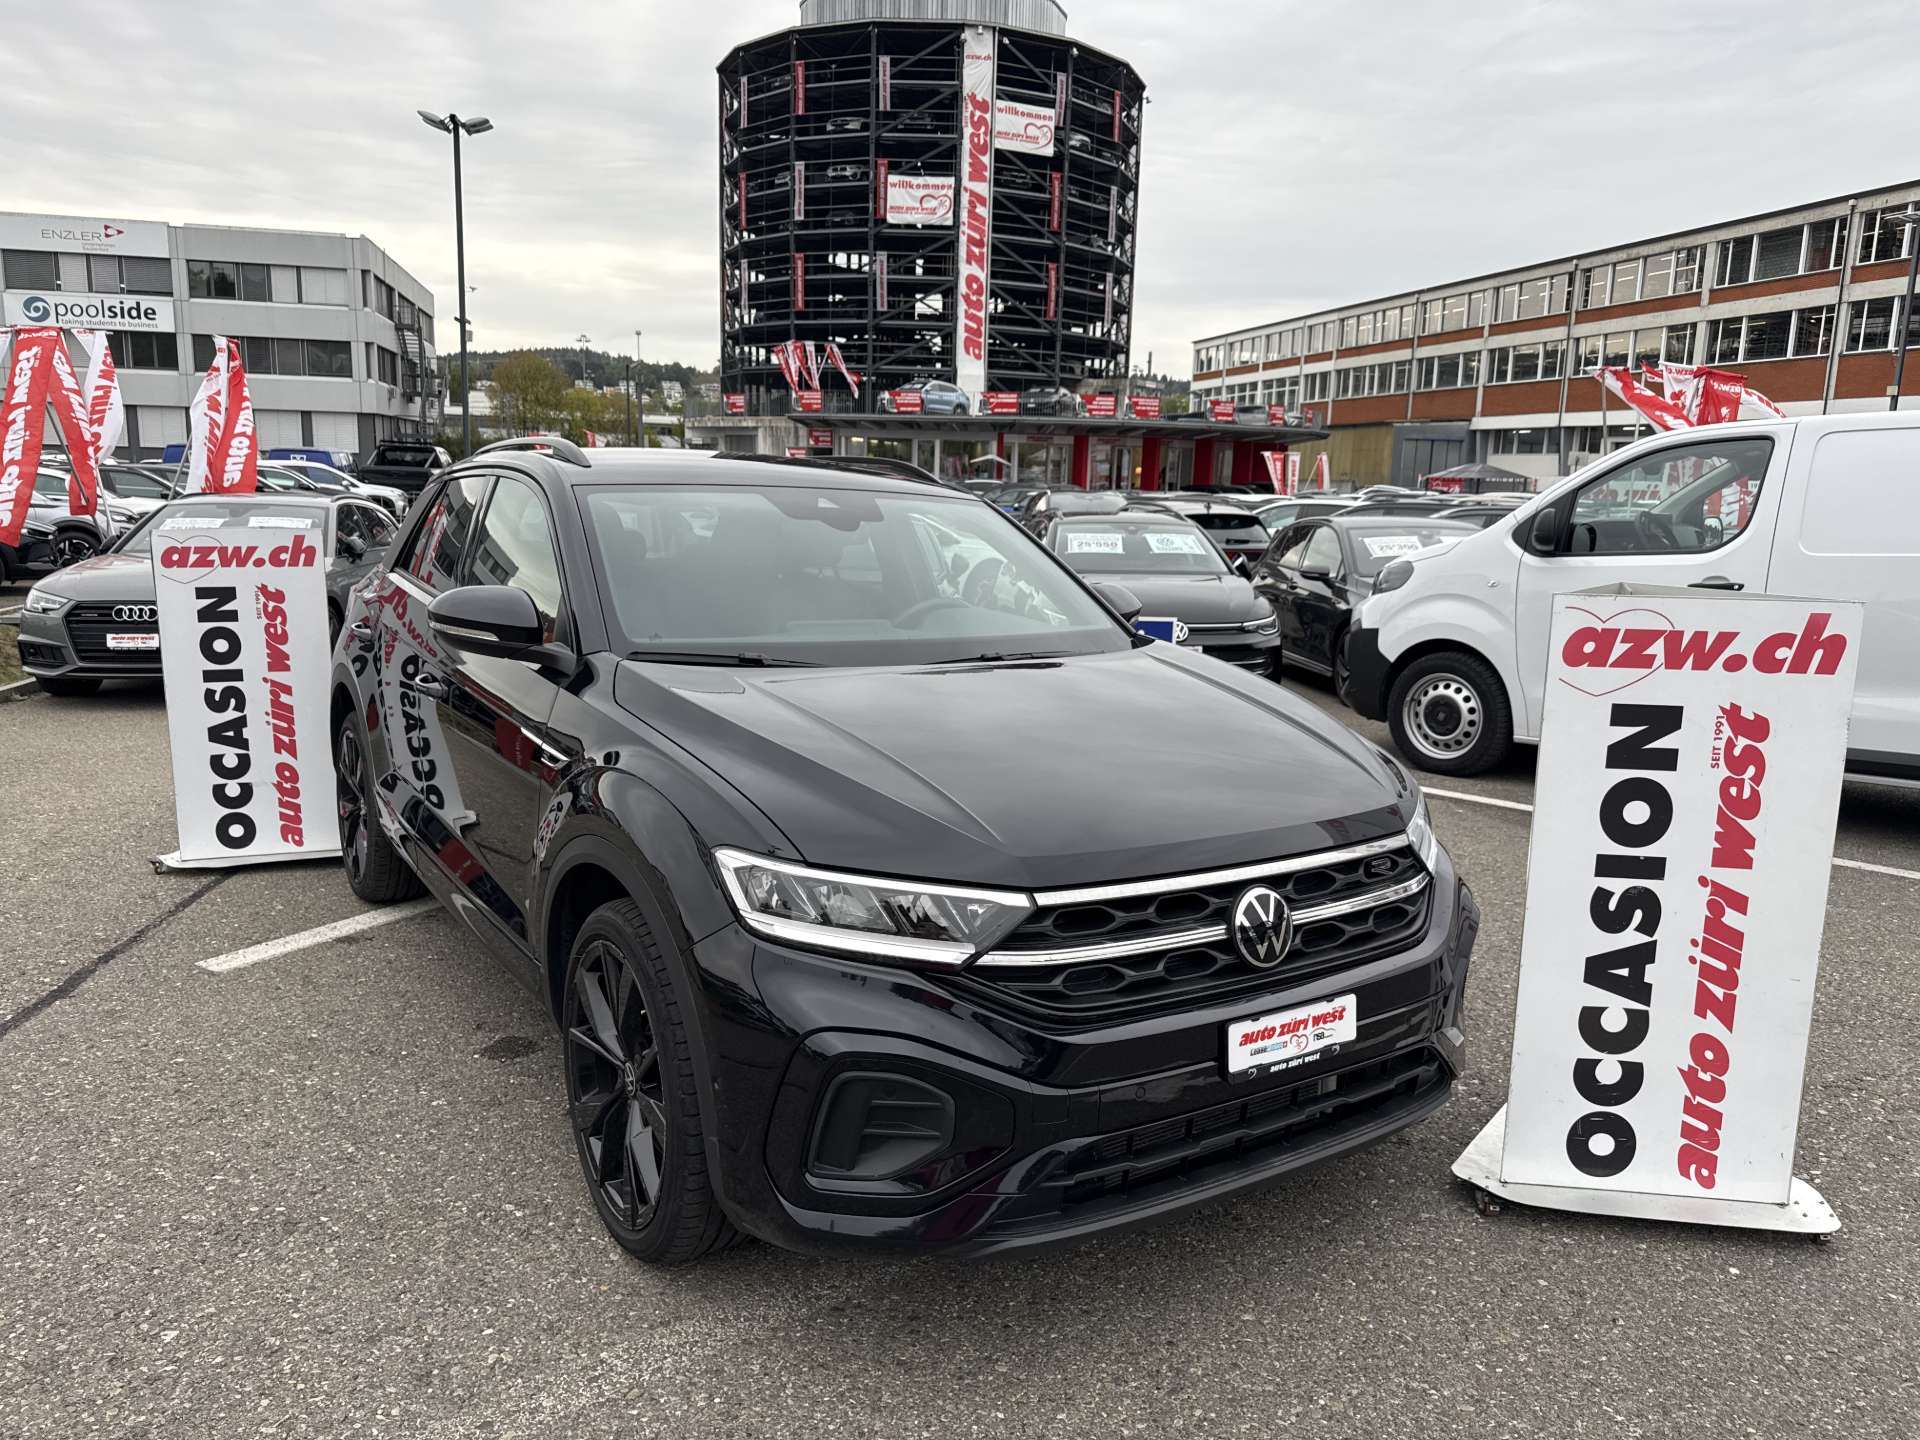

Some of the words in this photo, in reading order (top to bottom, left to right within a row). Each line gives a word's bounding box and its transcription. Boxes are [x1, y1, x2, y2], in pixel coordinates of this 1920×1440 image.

[967, 91, 990, 184] west
[996, 105, 1053, 121] willkommen
[889, 180, 952, 191] willkommen
[41, 228, 102, 242] ENZLER
[961, 186, 988, 271] züri
[54, 299, 157, 323] poolside
[61, 317, 84, 328] taking
[86, 318, 117, 328] students
[118, 320, 126, 328] to
[128, 320, 158, 329] business
[961, 274, 984, 361] auto
[160, 535, 317, 569] azw.ch
[258, 583, 291, 672] west
[1561, 612, 1847, 676] azw.ch
[195, 586, 257, 849] OCCASION
[262, 676, 298, 760] züri
[1713, 715, 1725, 741] 1991
[1711, 746, 1721, 769] SEIT
[1711, 702, 1771, 869] west
[272, 762, 305, 848] auto
[1566, 703, 1684, 1177] OCCASION
[1688, 875, 1749, 1034] züri
[1239, 1025, 1277, 1047] auto
[1277, 1014, 1311, 1037] züri
[1312, 1008, 1346, 1028] west
[1270, 1062, 1287, 1073] auto
[1288, 1057, 1304, 1068] züri
[1304, 1052, 1321, 1064] west
[1677, 1033, 1731, 1190] auto
